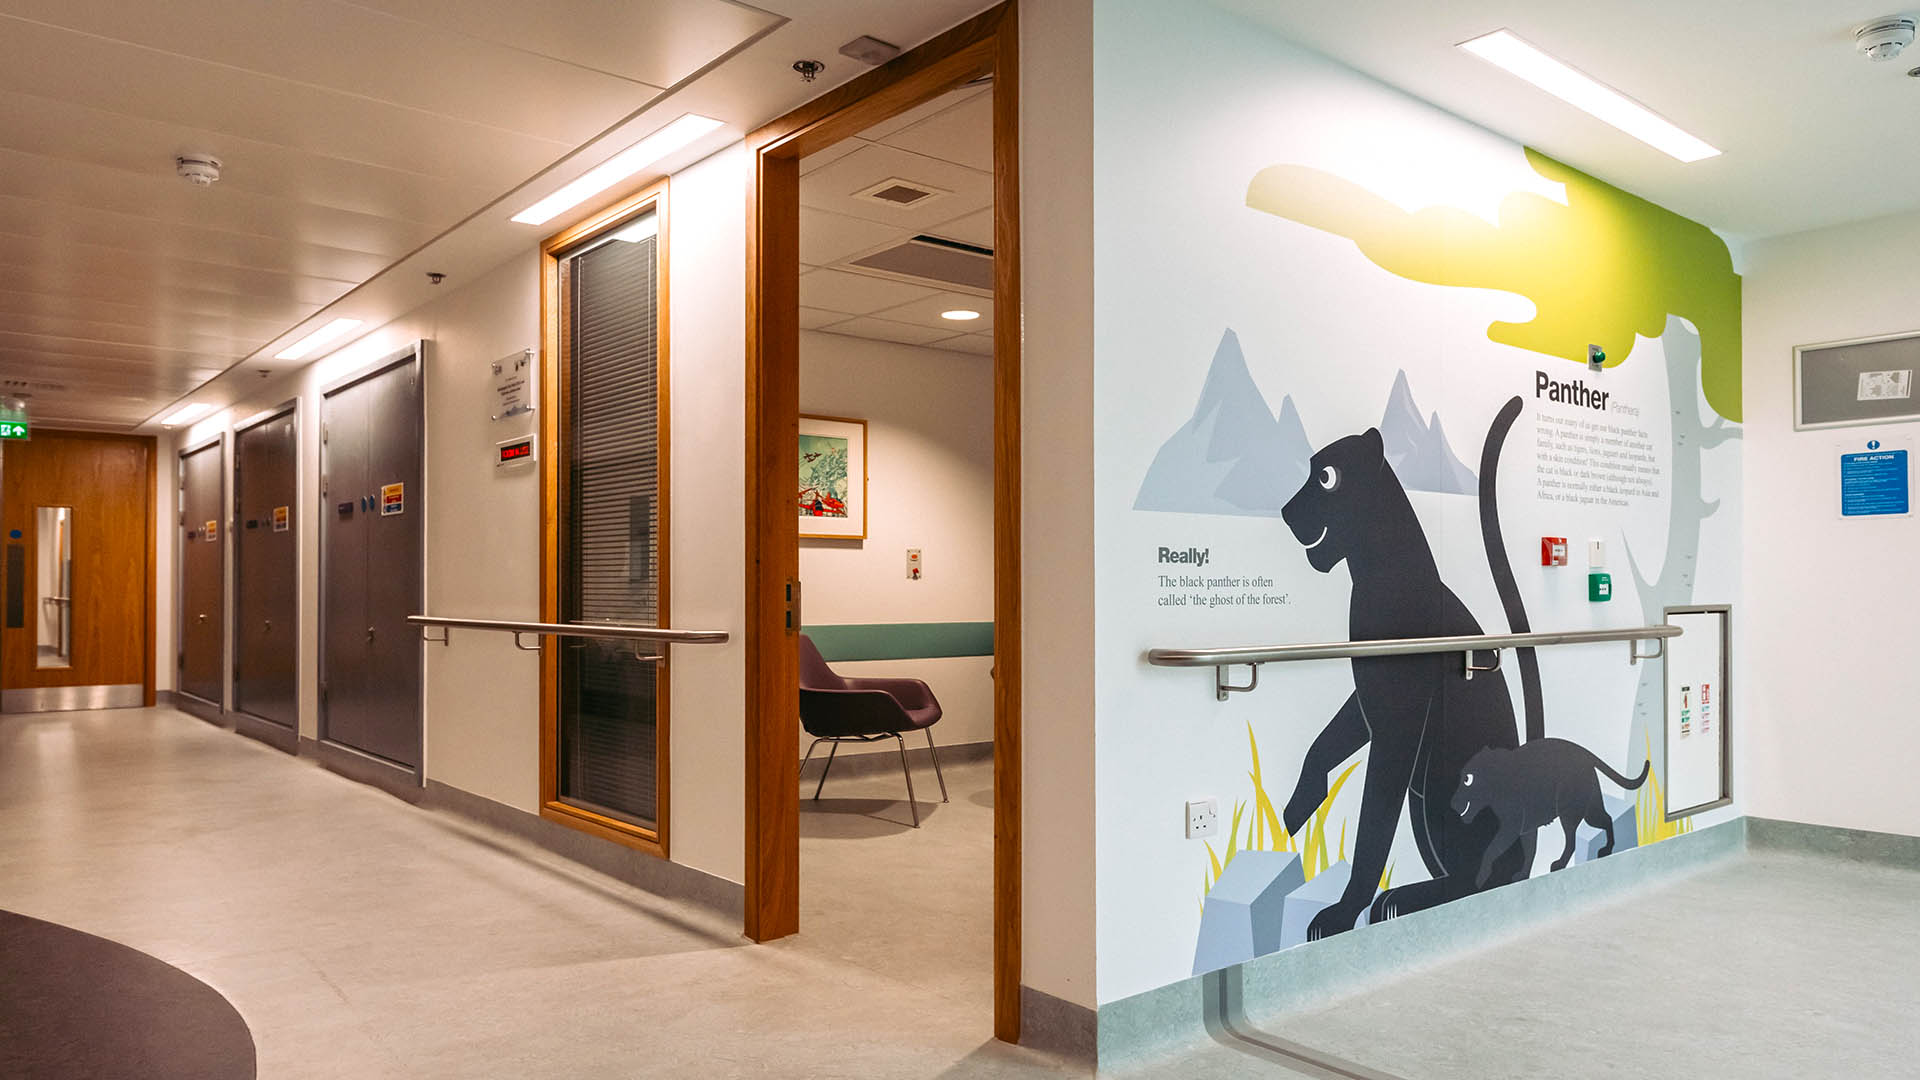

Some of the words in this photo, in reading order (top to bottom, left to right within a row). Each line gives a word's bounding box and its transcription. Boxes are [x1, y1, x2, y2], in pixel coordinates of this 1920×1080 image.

[1536, 370, 1609, 410] Panther
[1158, 547, 1209, 567] Really!
[1158, 576, 1177, 587] The
[1179, 576, 1204, 587] black
[1207, 576, 1240, 590] panther
[1243, 576, 1250, 587] is
[1252, 576, 1273, 587] often
[1158, 594, 1186, 606] called
[1190, 594, 1207, 606] ‘the
[1210, 594, 1233, 608] ghost
[1235, 594, 1246, 605] of
[1247, 594, 1260, 605] the
